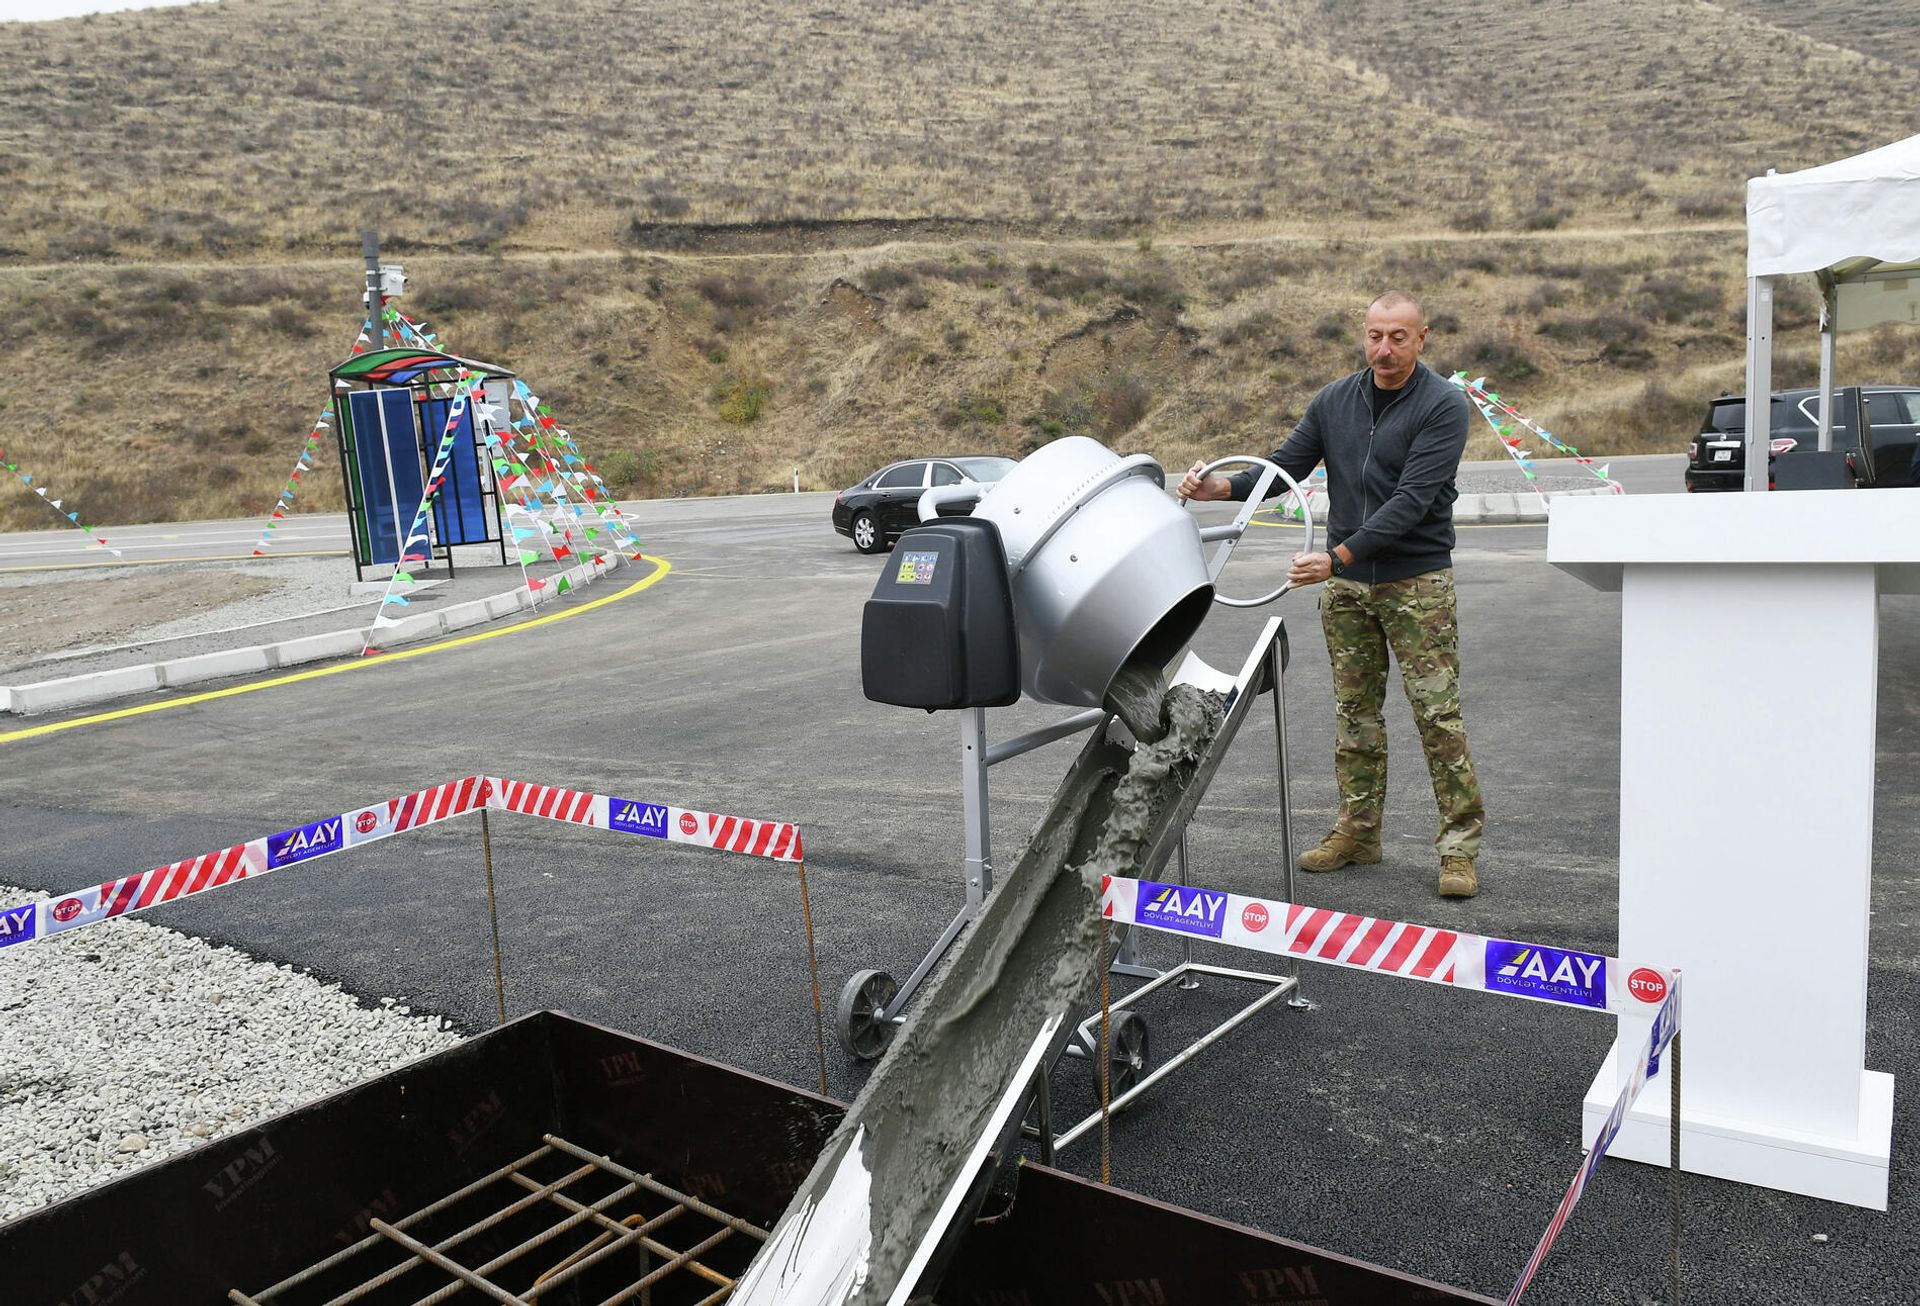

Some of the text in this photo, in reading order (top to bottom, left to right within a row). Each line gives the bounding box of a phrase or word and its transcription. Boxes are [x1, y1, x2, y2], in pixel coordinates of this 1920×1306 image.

[627, 803, 666, 828] AAY
[680, 819, 697, 828] STOP
[291, 819, 340, 852] AAY
[55, 903, 81, 916] STOP
[1162, 889, 1224, 922] AAY
[1243, 911, 1267, 923] STOP
[1521, 951, 1602, 988] AAY
[1497, 976, 1537, 989] DÖVLƏT
[1631, 979, 1664, 993] STOP
[201, 1136, 277, 1199] VPM
[1238, 1265, 1321, 1300] VPM
